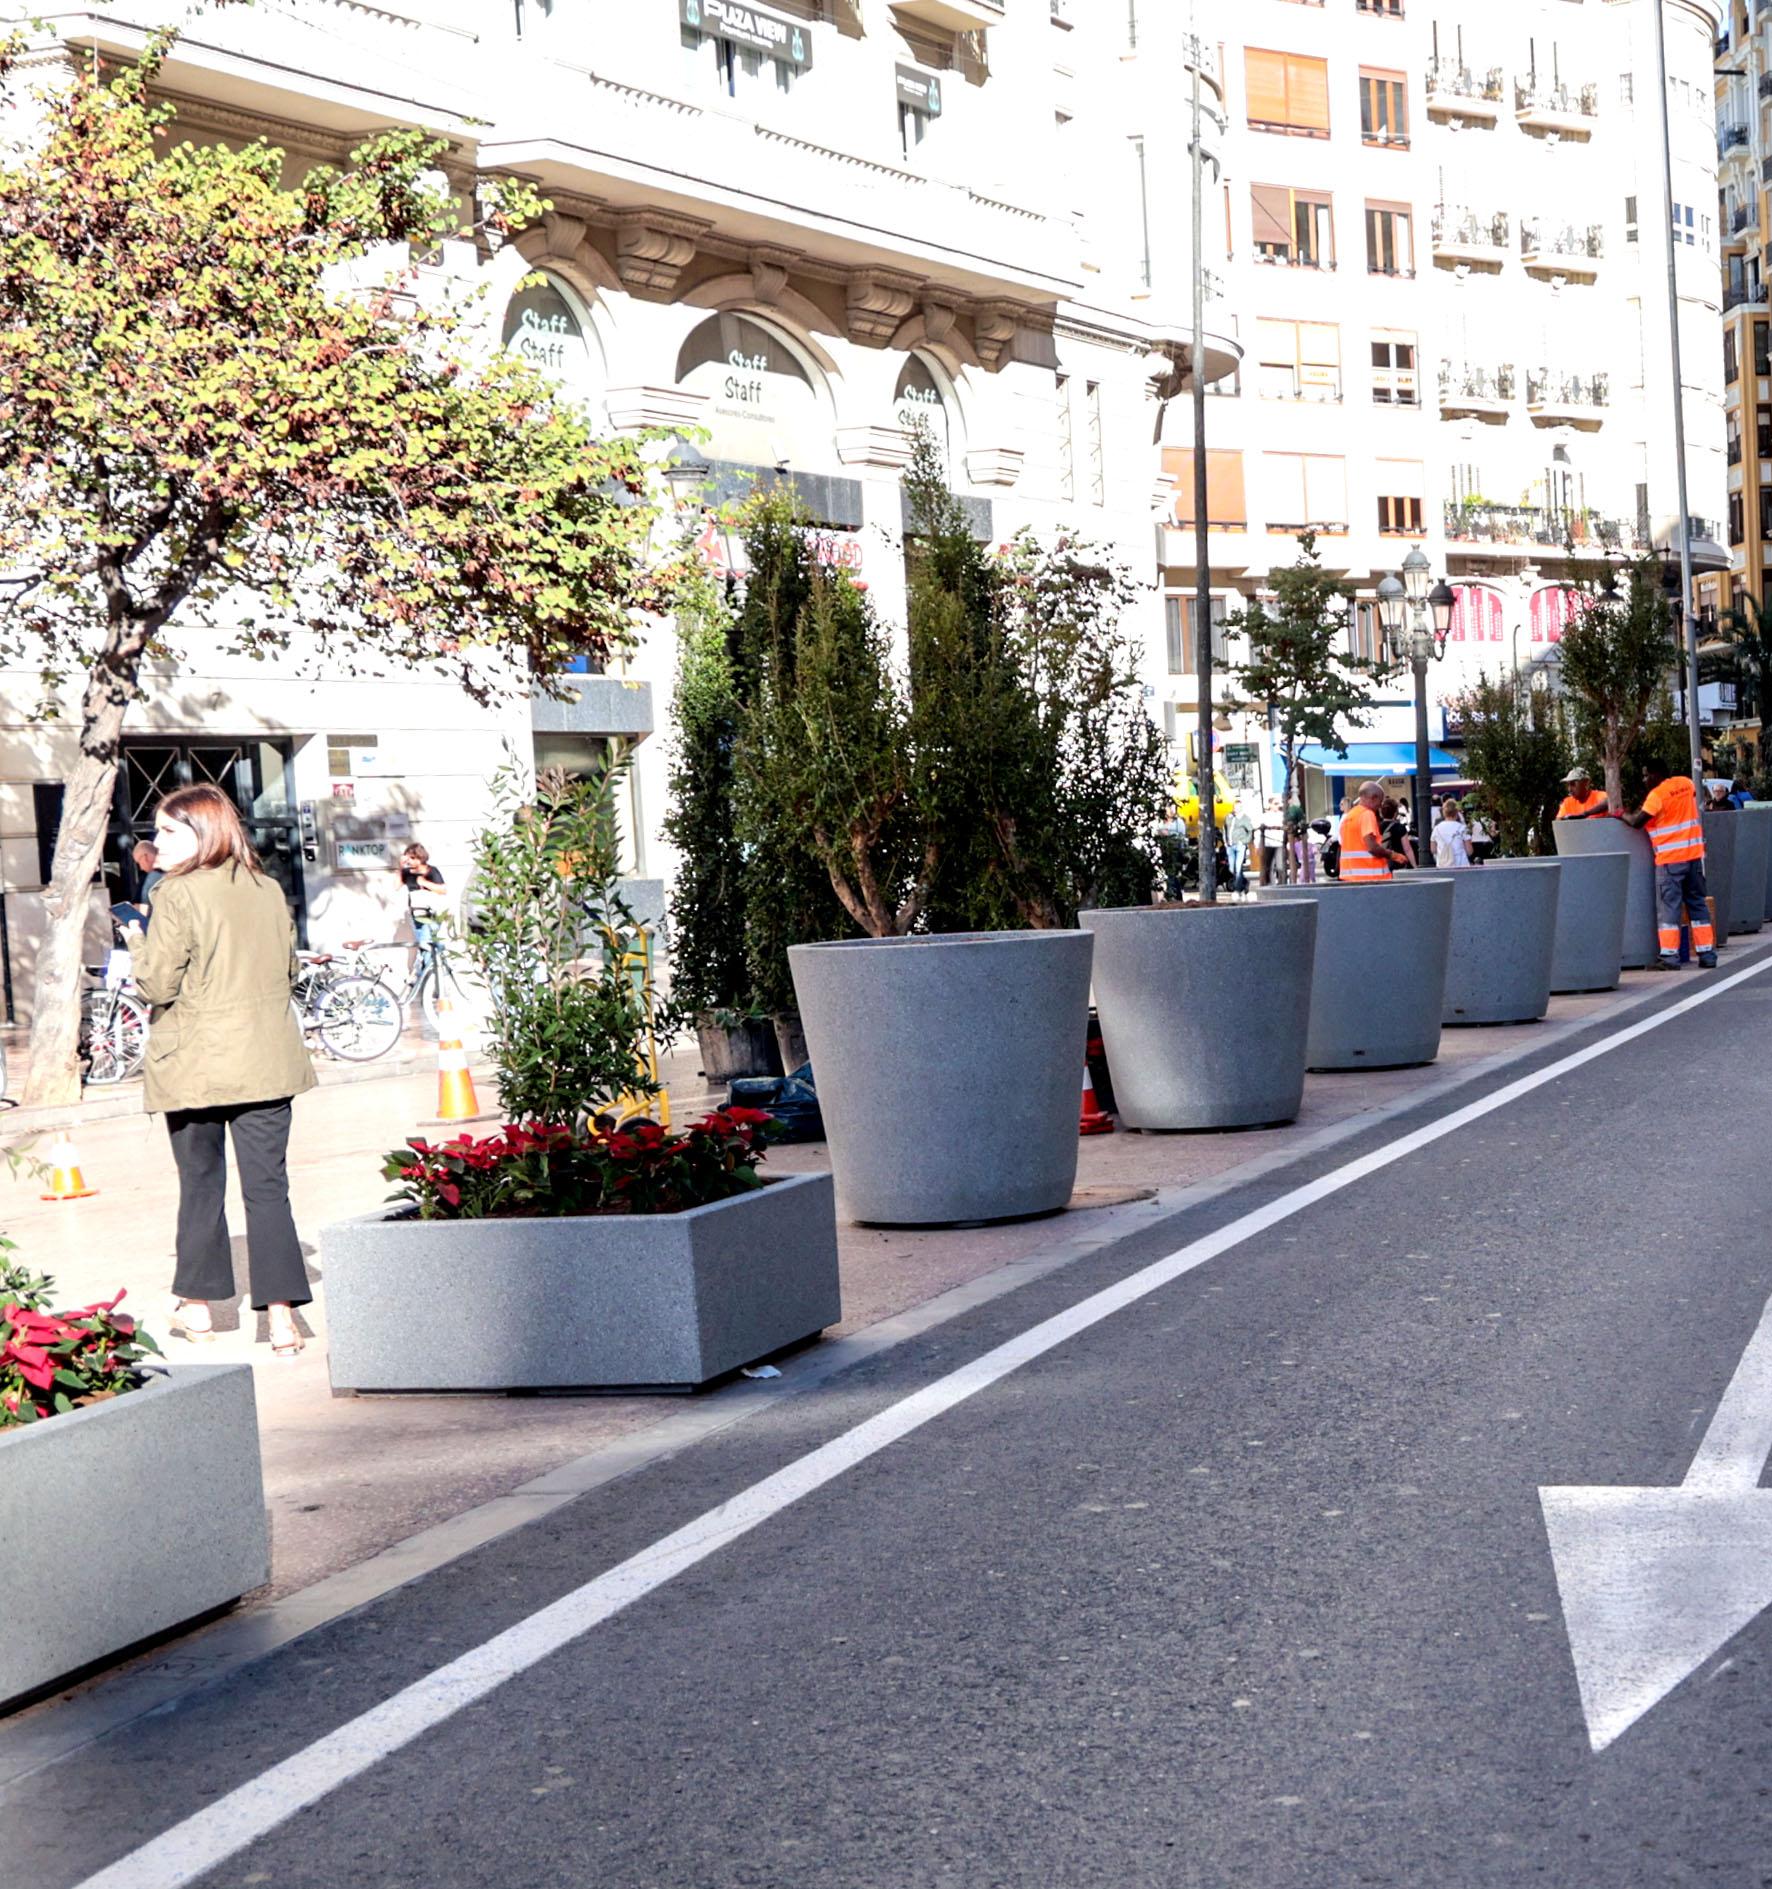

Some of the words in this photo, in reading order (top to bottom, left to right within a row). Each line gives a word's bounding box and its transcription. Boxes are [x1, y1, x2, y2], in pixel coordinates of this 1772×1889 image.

[754, 15, 787, 44] VIEW
[520, 337, 564, 368] Staff
[725, 376, 762, 403] Staff
